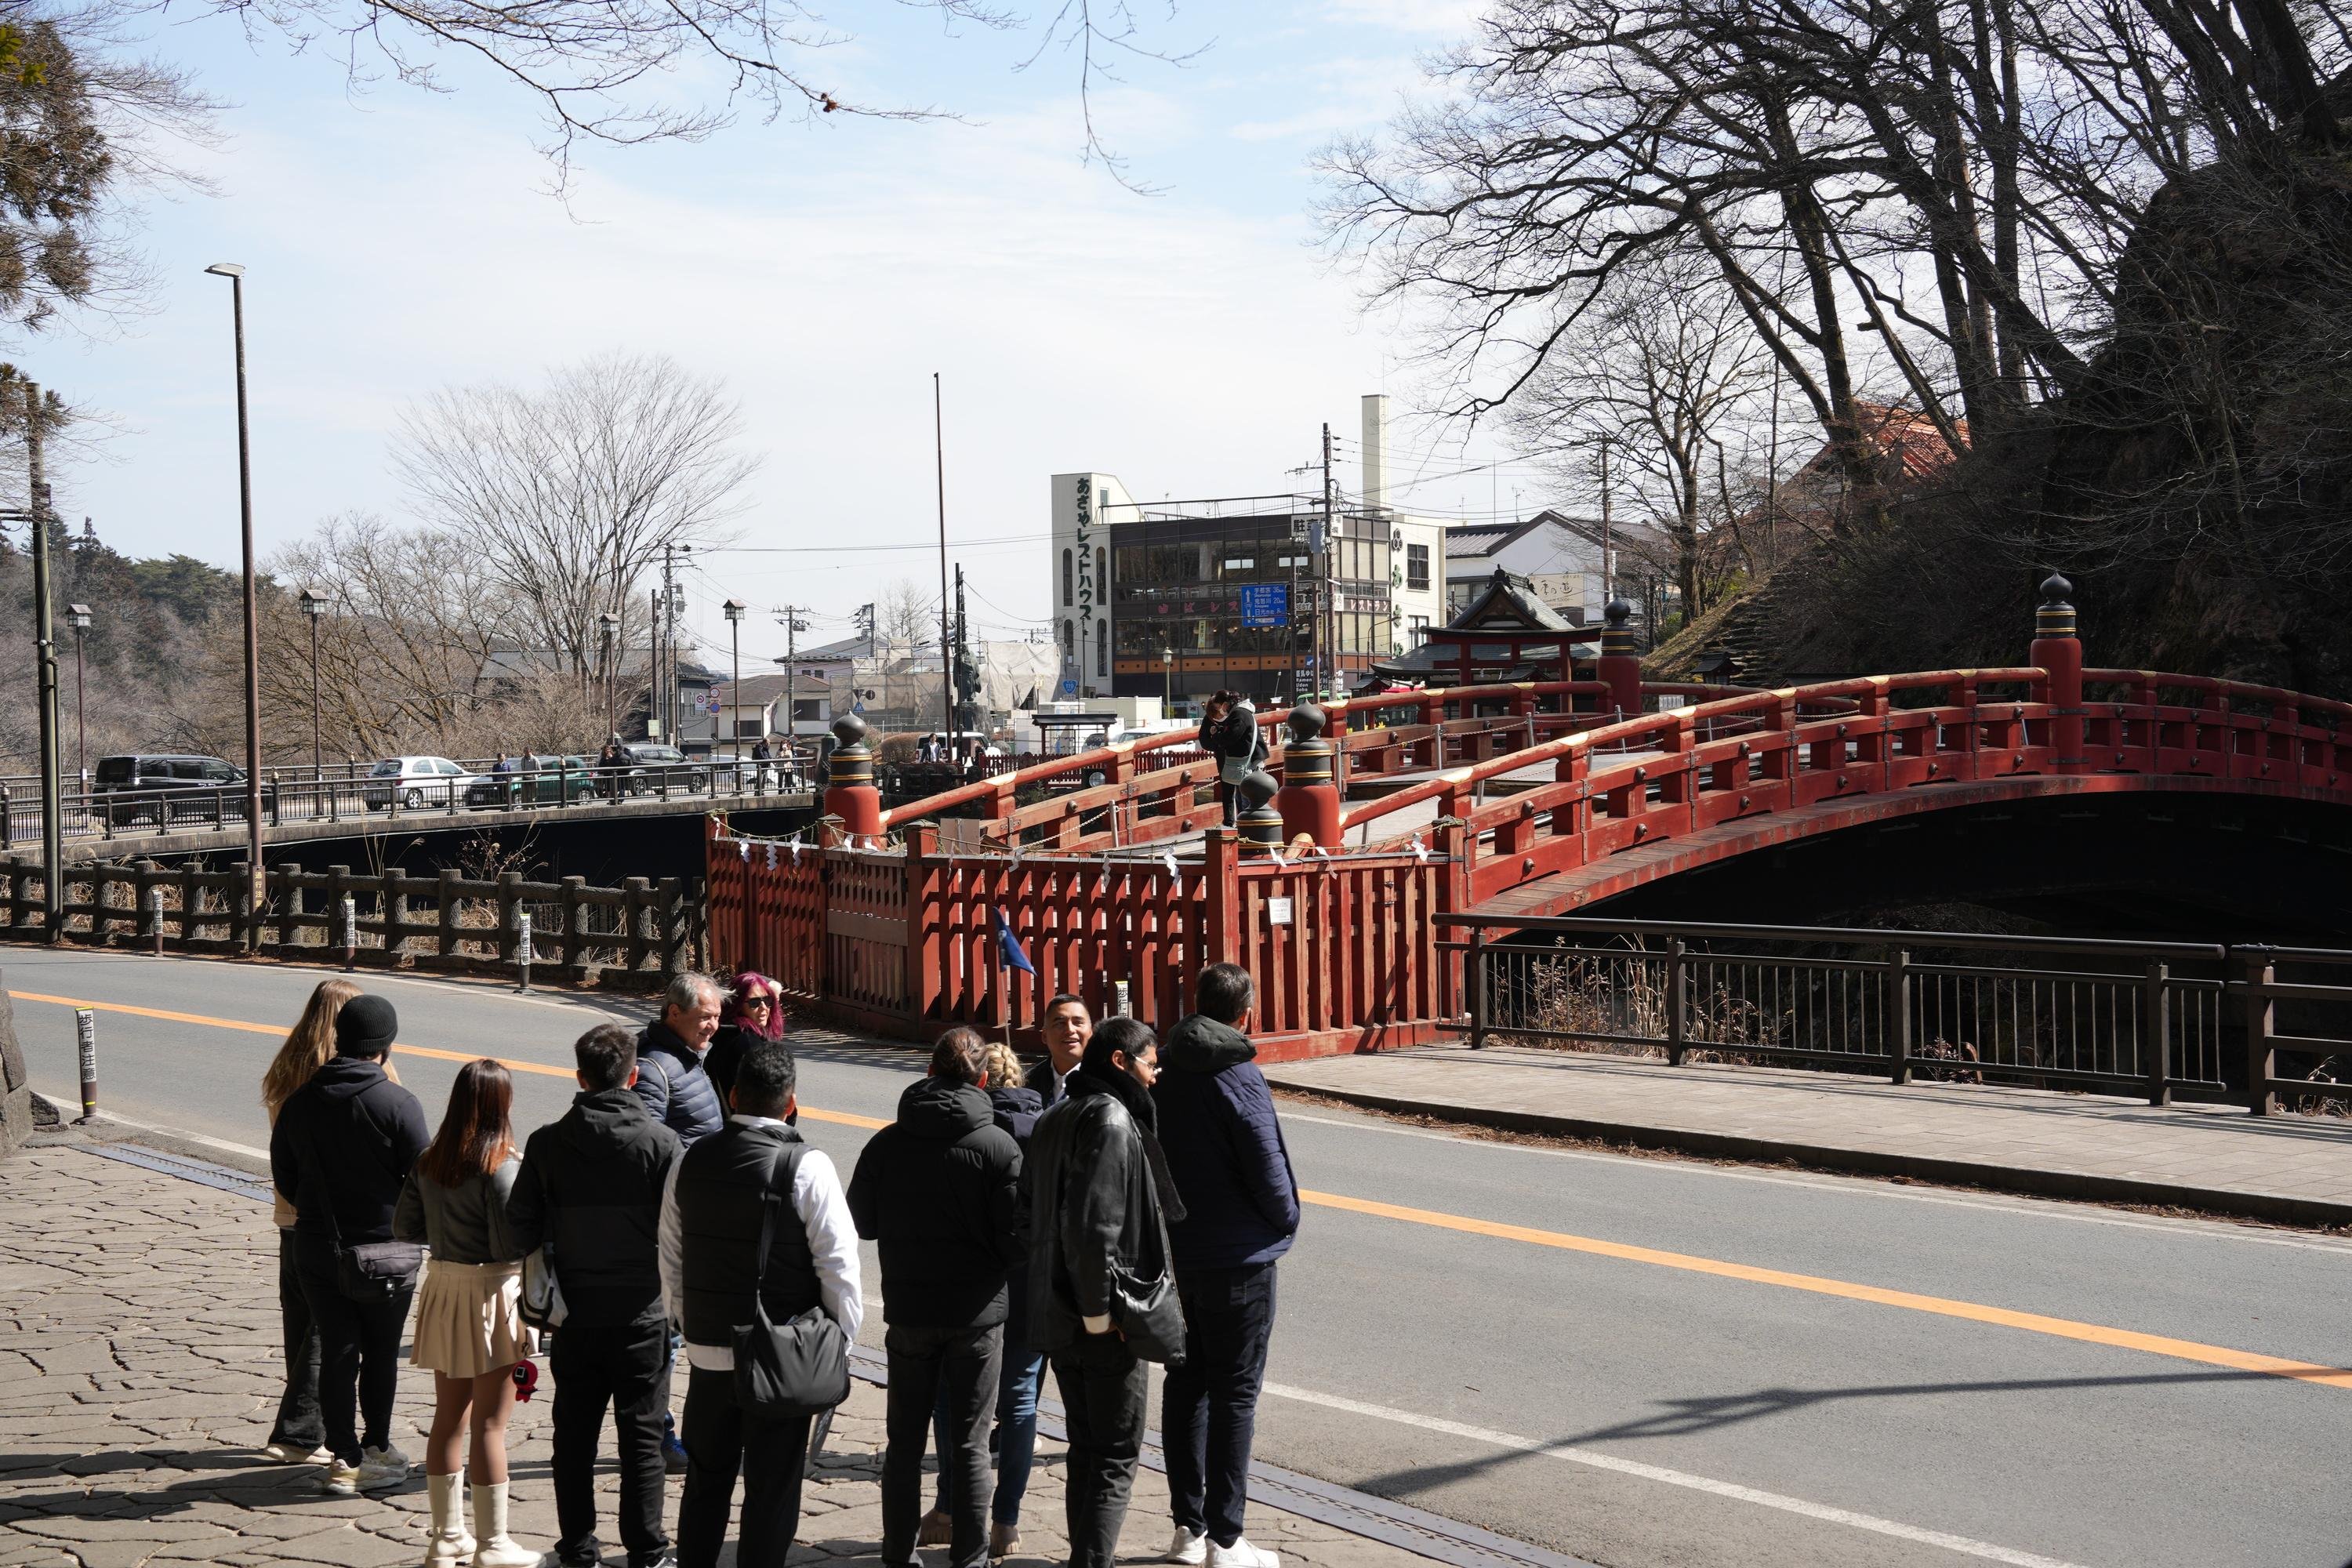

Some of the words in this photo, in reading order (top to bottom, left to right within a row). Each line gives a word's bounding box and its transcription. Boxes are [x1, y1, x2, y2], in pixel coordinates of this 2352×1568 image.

[1077, 477, 1092, 620] あさやレストハウス
[1349, 599, 1388, 612] レストラン
[1392, 564, 1403, 657] あさや
[1118, 987, 1128, 1016] 歩行
[79, 1014, 96, 1080] 歩行者注意
